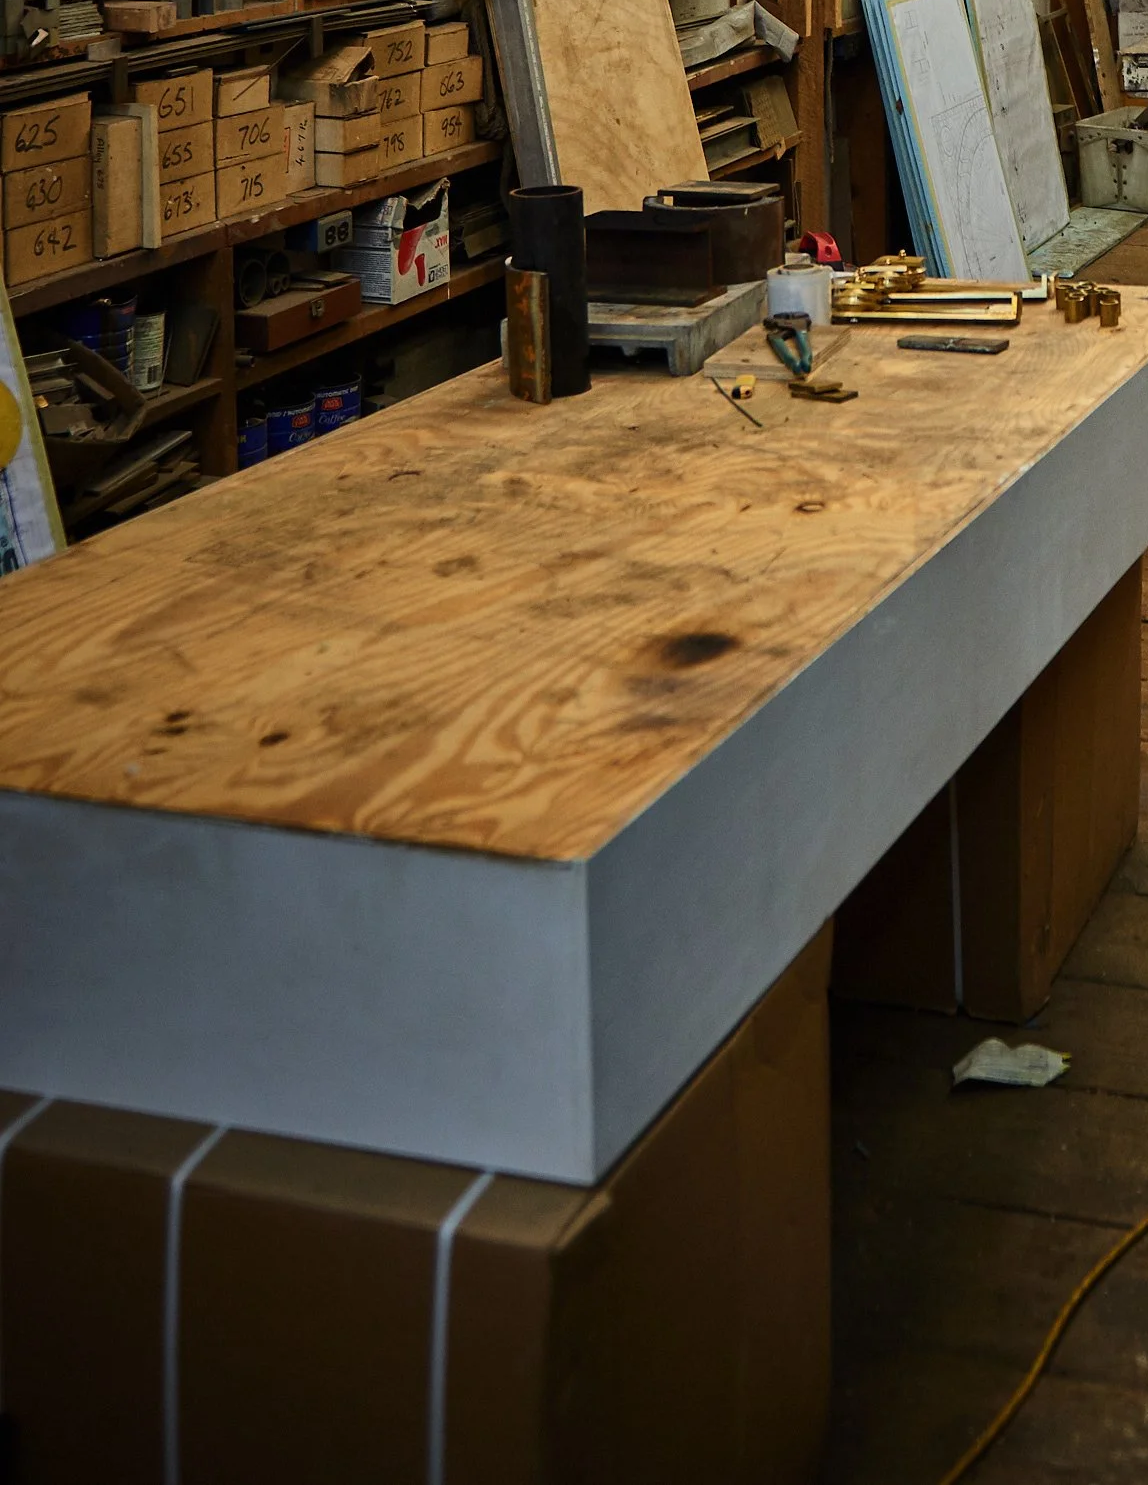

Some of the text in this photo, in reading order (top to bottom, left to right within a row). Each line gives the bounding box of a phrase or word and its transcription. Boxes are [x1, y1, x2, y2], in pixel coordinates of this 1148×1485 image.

[387, 41, 413, 65] 752
[158, 86, 194, 119] 651
[378, 89, 405, 112] 762
[15, 115, 60, 152] 625
[238, 117, 270, 149] 706
[441, 117, 463, 138] 954
[162, 141, 193, 169] 655
[25, 176, 63, 211] 630
[241, 173, 263, 201] 715
[163, 190, 194, 221] 673
[33, 225, 77, 257] 642
